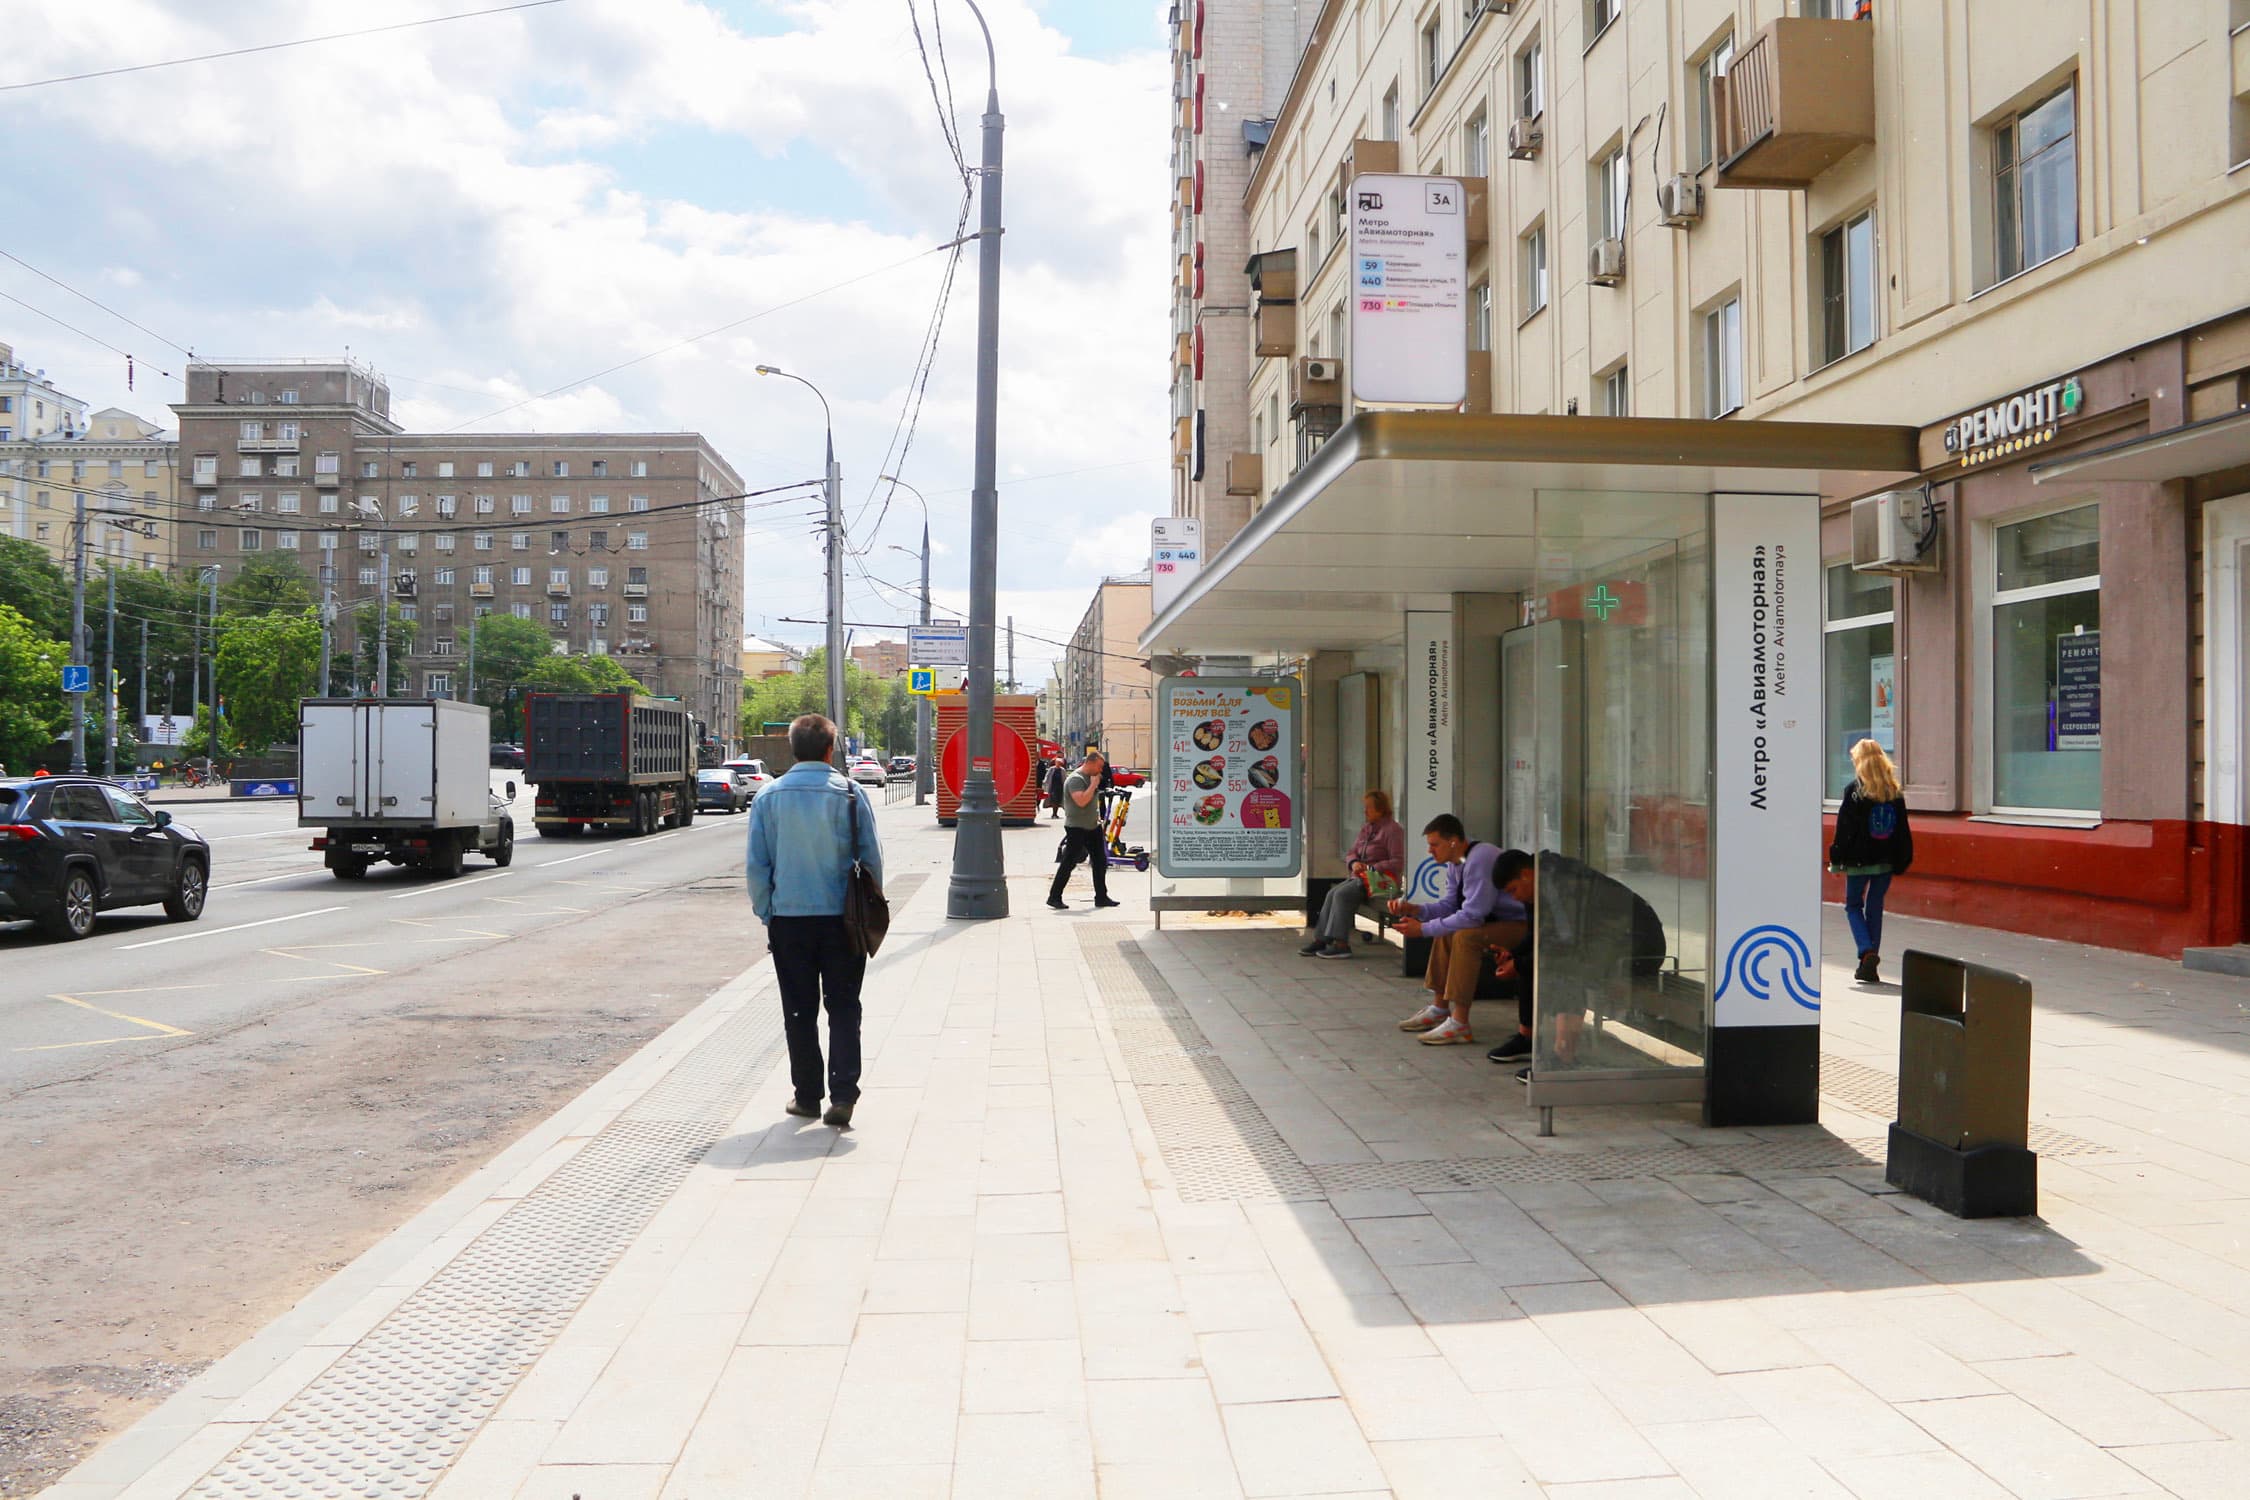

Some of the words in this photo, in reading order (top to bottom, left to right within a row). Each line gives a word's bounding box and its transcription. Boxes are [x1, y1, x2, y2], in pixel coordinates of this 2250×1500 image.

[1358, 217, 1390, 228] Метро
[1358, 227, 1435, 238] «Авиамоторная»
[1365, 261, 1378, 271] 59
[1361, 276, 1382, 287] 440
[1361, 300, 1382, 311] 730
[1959, 382, 2062, 452] РЕМОНТ
[1160, 551, 1171, 560] 59
[1178, 551, 1195, 560] 440
[1157, 563, 1174, 572] 730
[1773, 544, 1786, 647] Aviamotornaya
[1750, 544, 1769, 730] «Авиамоторная»
[2062, 647, 2099, 659] РЕМОНТ
[1774, 651, 1785, 696] Metro
[1426, 640, 1439, 746] «Авиамоторная»
[1173, 697, 1216, 707] ВОЗЬМИ
[1217, 697, 1242, 708] ДЛЯ
[1173, 708, 1209, 718] ГРИЛЯ
[1210, 707, 1232, 717] ВСЁ
[2062, 722, 2100, 731] КСЕРОКОПИЯ
[1173, 740, 1185, 753] 41
[1228, 740, 1241, 753] 27
[1426, 748, 1440, 792] Метро
[1750, 736, 1770, 811] Метро
[1173, 779, 1187, 792] 79
[1228, 779, 1242, 792] 55
[1173, 814, 1187, 826] 44
